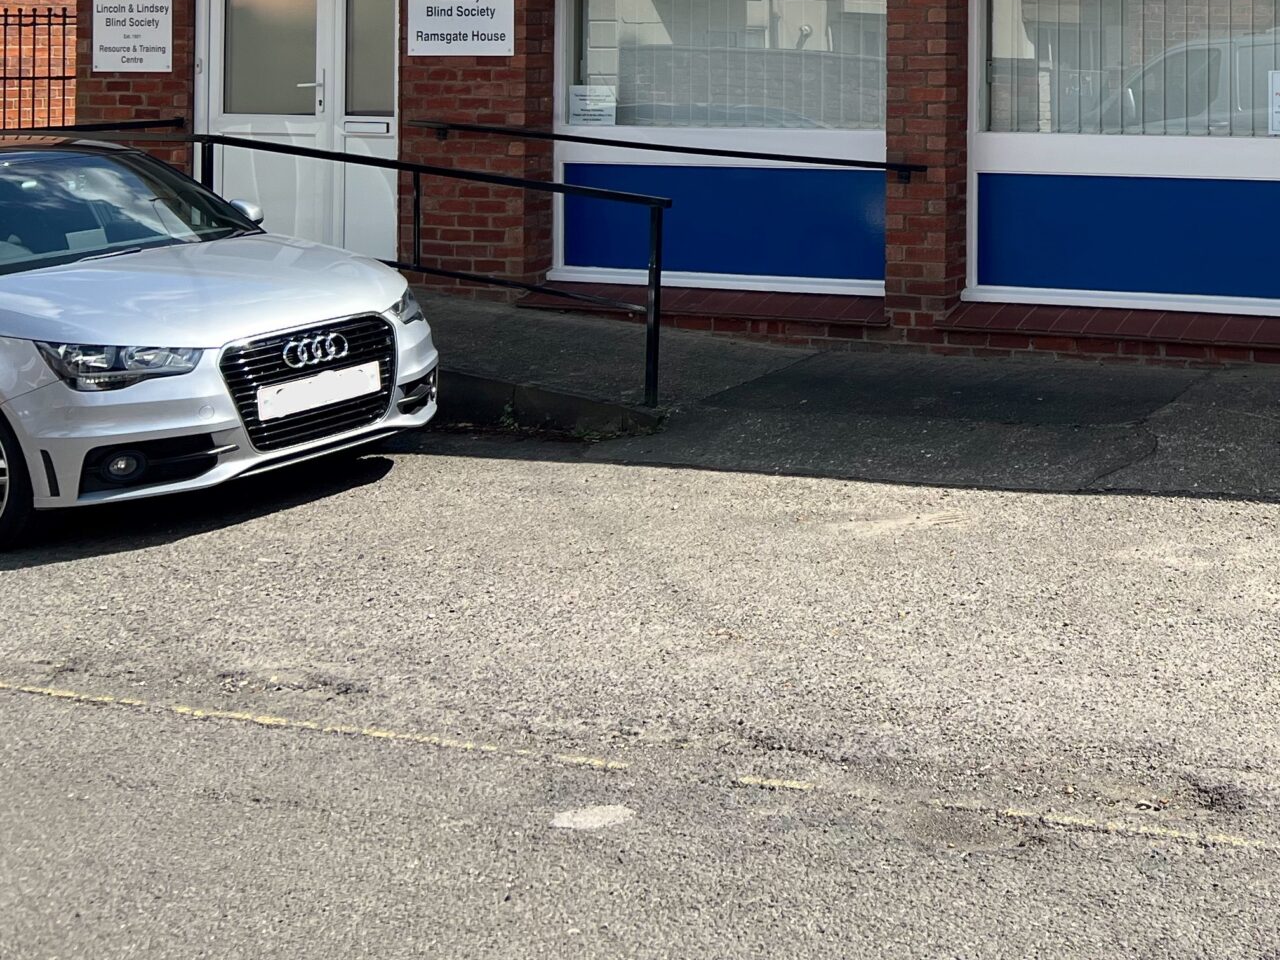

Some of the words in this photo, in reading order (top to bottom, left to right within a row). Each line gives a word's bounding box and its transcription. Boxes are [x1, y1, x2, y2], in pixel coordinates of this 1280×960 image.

[96, 3, 126, 13] Lincoln
[128, 3, 134, 13] &
[136, 3, 169, 15] Lindsey
[426, 6, 453, 17] Blind
[456, 5, 496, 19] Society
[105, 17, 126, 27] Blind
[128, 17, 159, 28] Society
[416, 30, 469, 44] Ramsgate
[471, 30, 506, 42] House
[99, 44, 131, 53] Resource
[132, 45, 137, 53] &
[139, 44, 166, 54] Training
